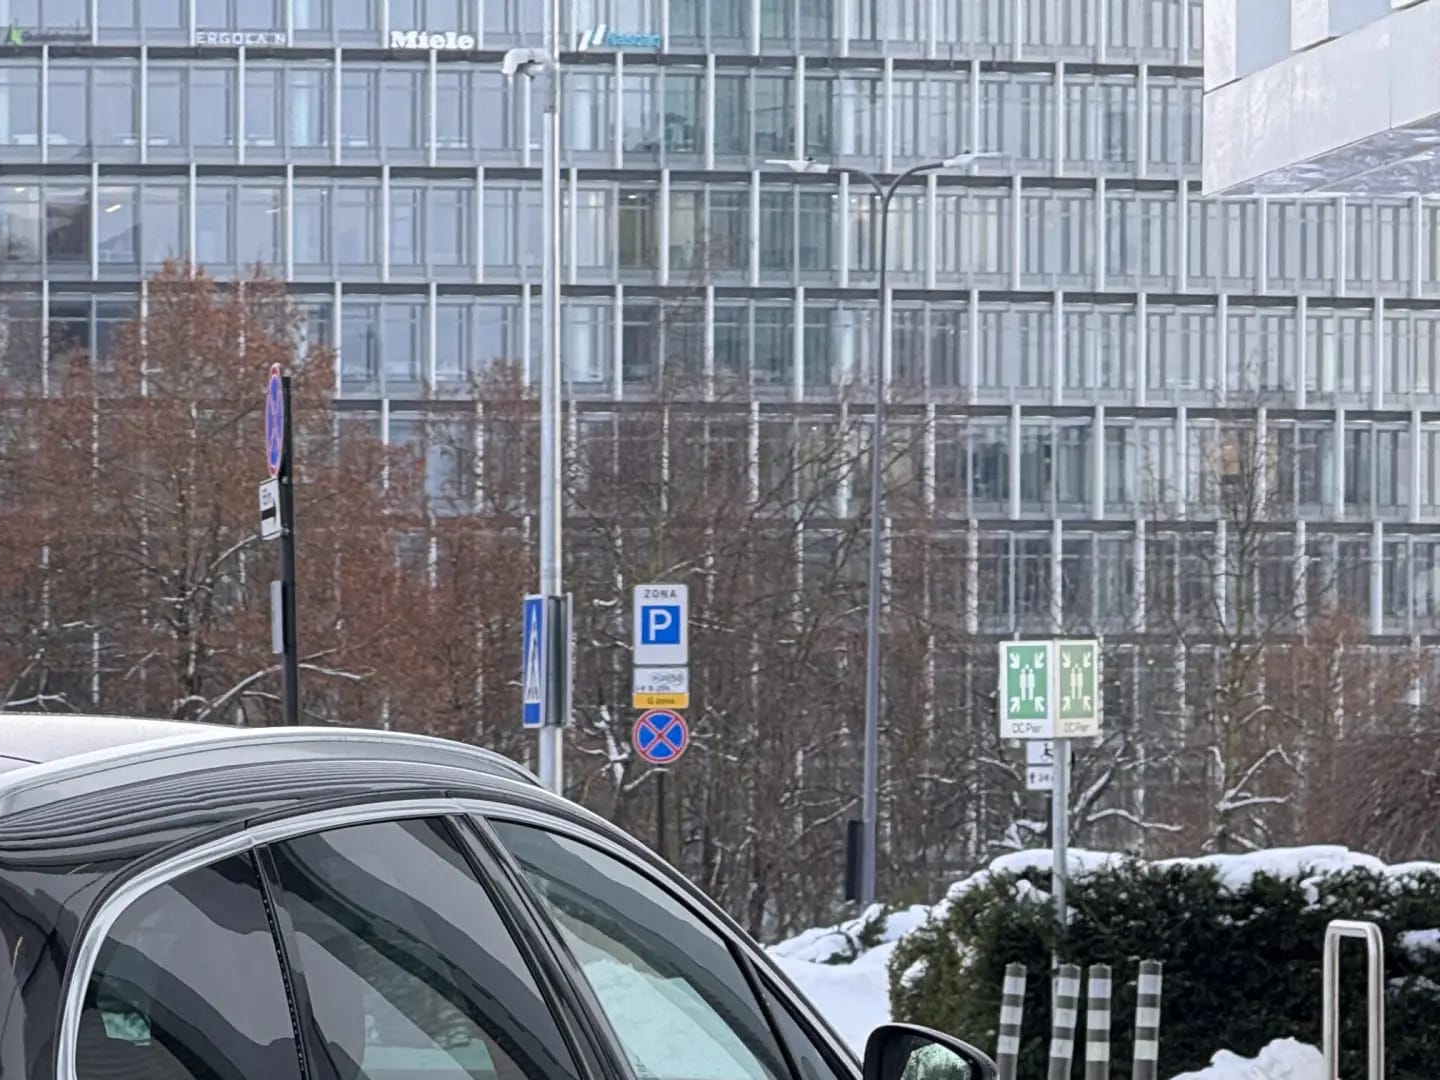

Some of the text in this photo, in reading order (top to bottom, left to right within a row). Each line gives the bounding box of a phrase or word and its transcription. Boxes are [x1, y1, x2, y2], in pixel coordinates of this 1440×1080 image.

[391, 30, 475, 49] Miele
[643, 589, 677, 599] ZONA
[649, 609, 672, 641] P
